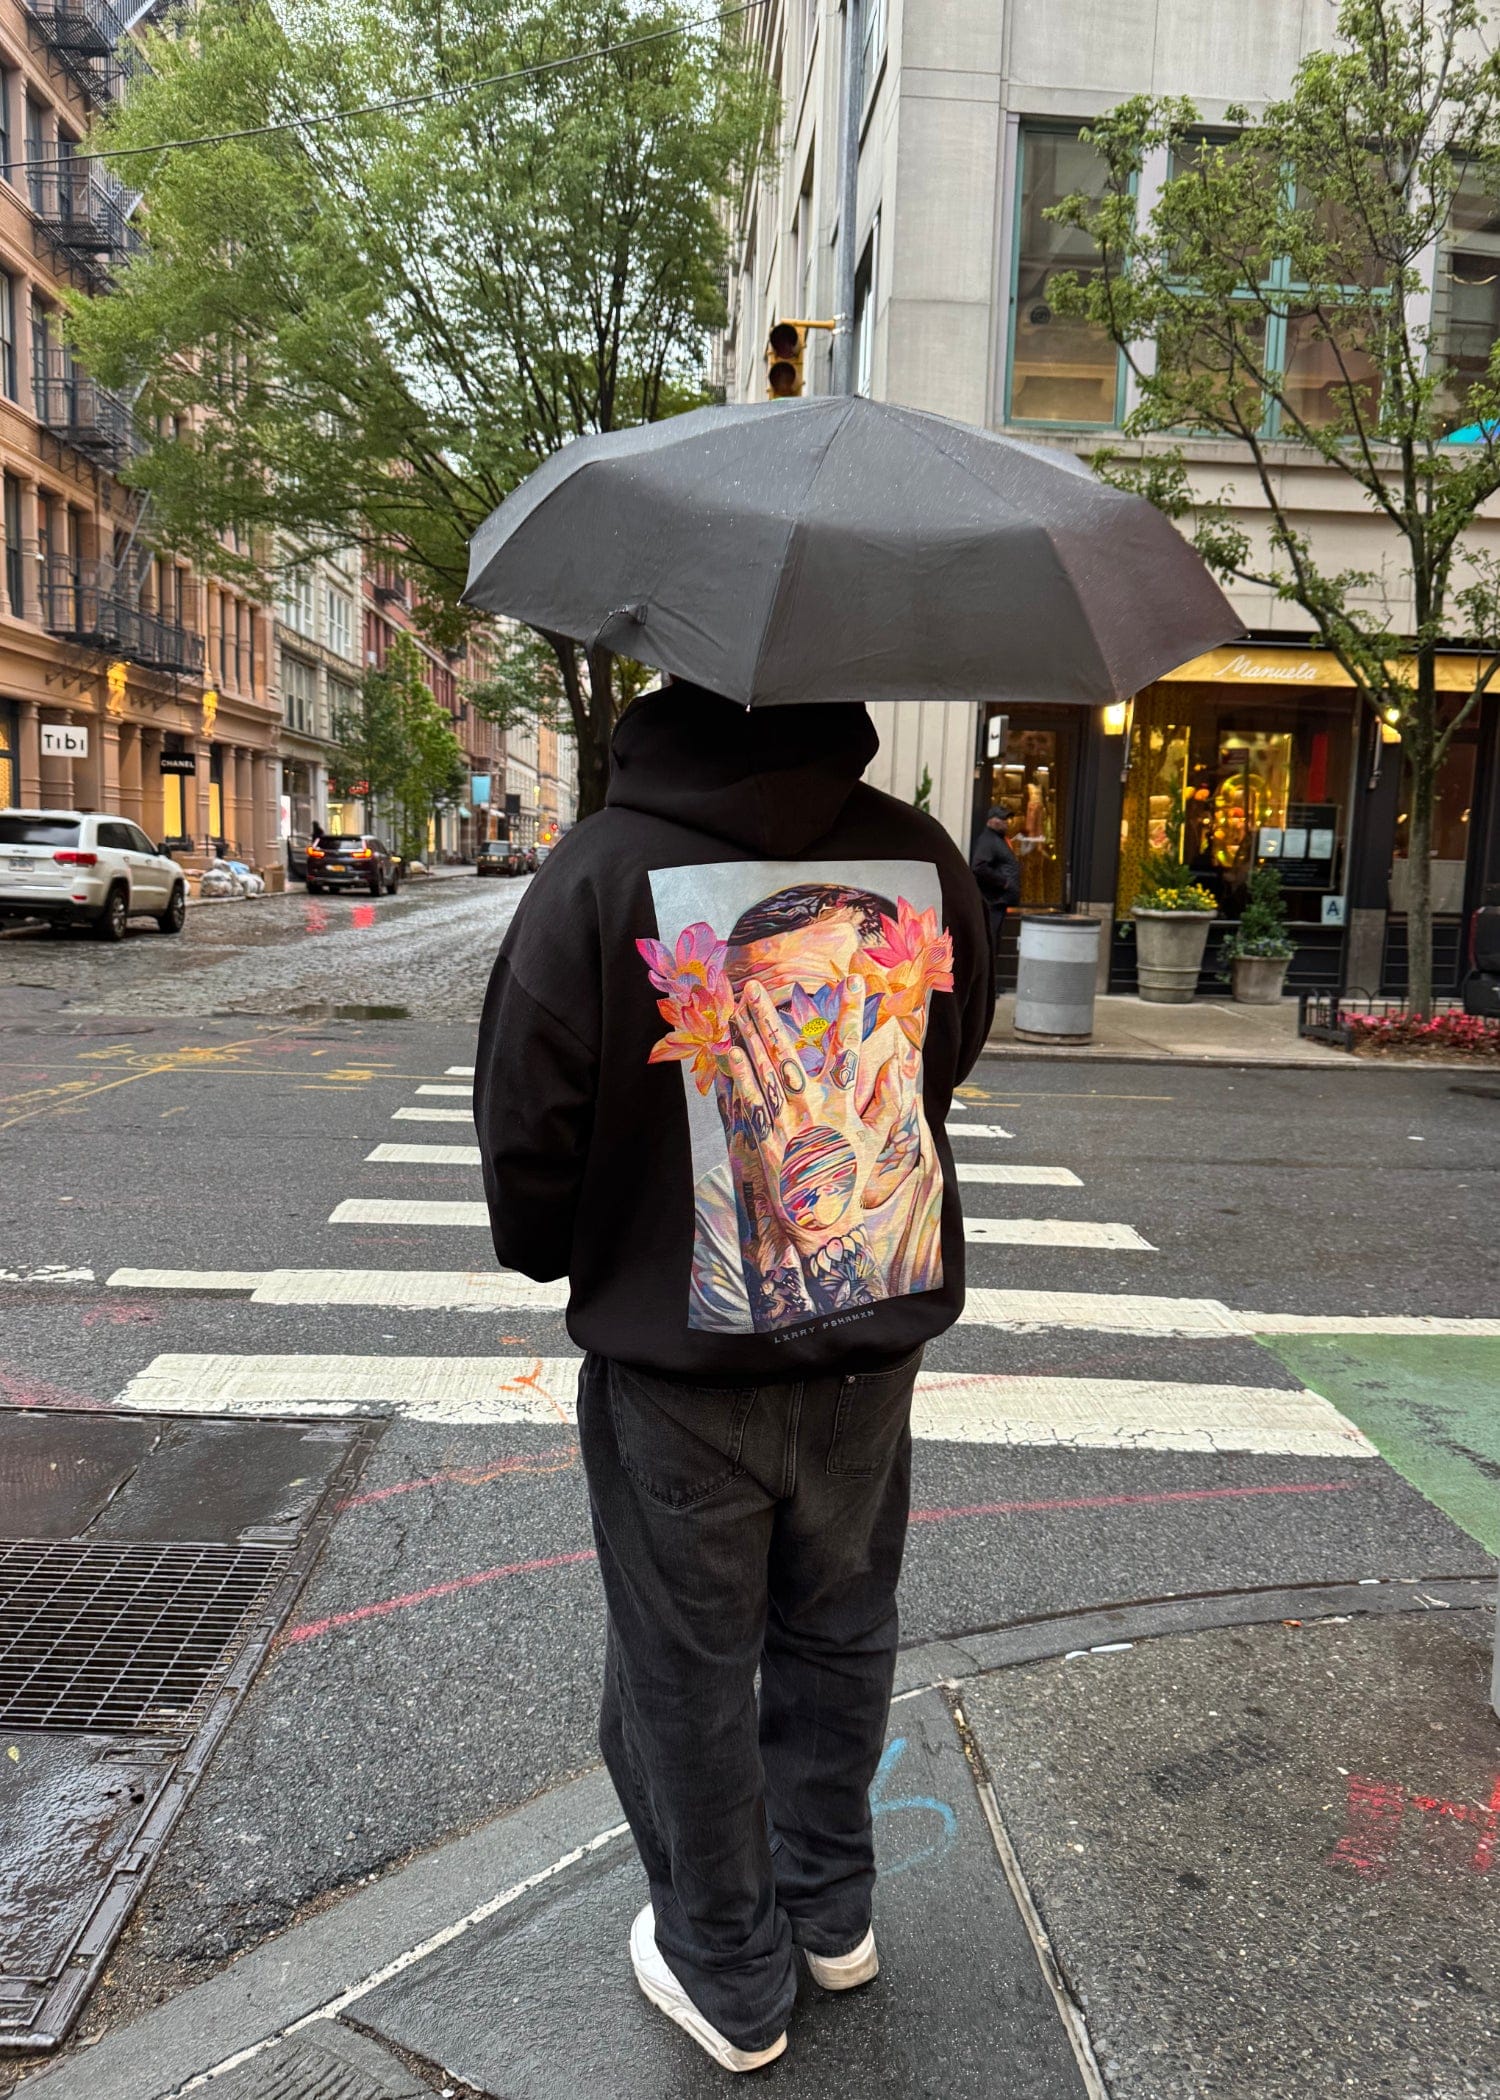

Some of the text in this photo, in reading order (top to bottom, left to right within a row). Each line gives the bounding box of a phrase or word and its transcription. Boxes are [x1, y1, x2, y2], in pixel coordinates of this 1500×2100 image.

[1214, 654, 1317, 680] Manuela
[160, 759, 195, 769] CHANEL
[1326, 900, 1339, 916] A
